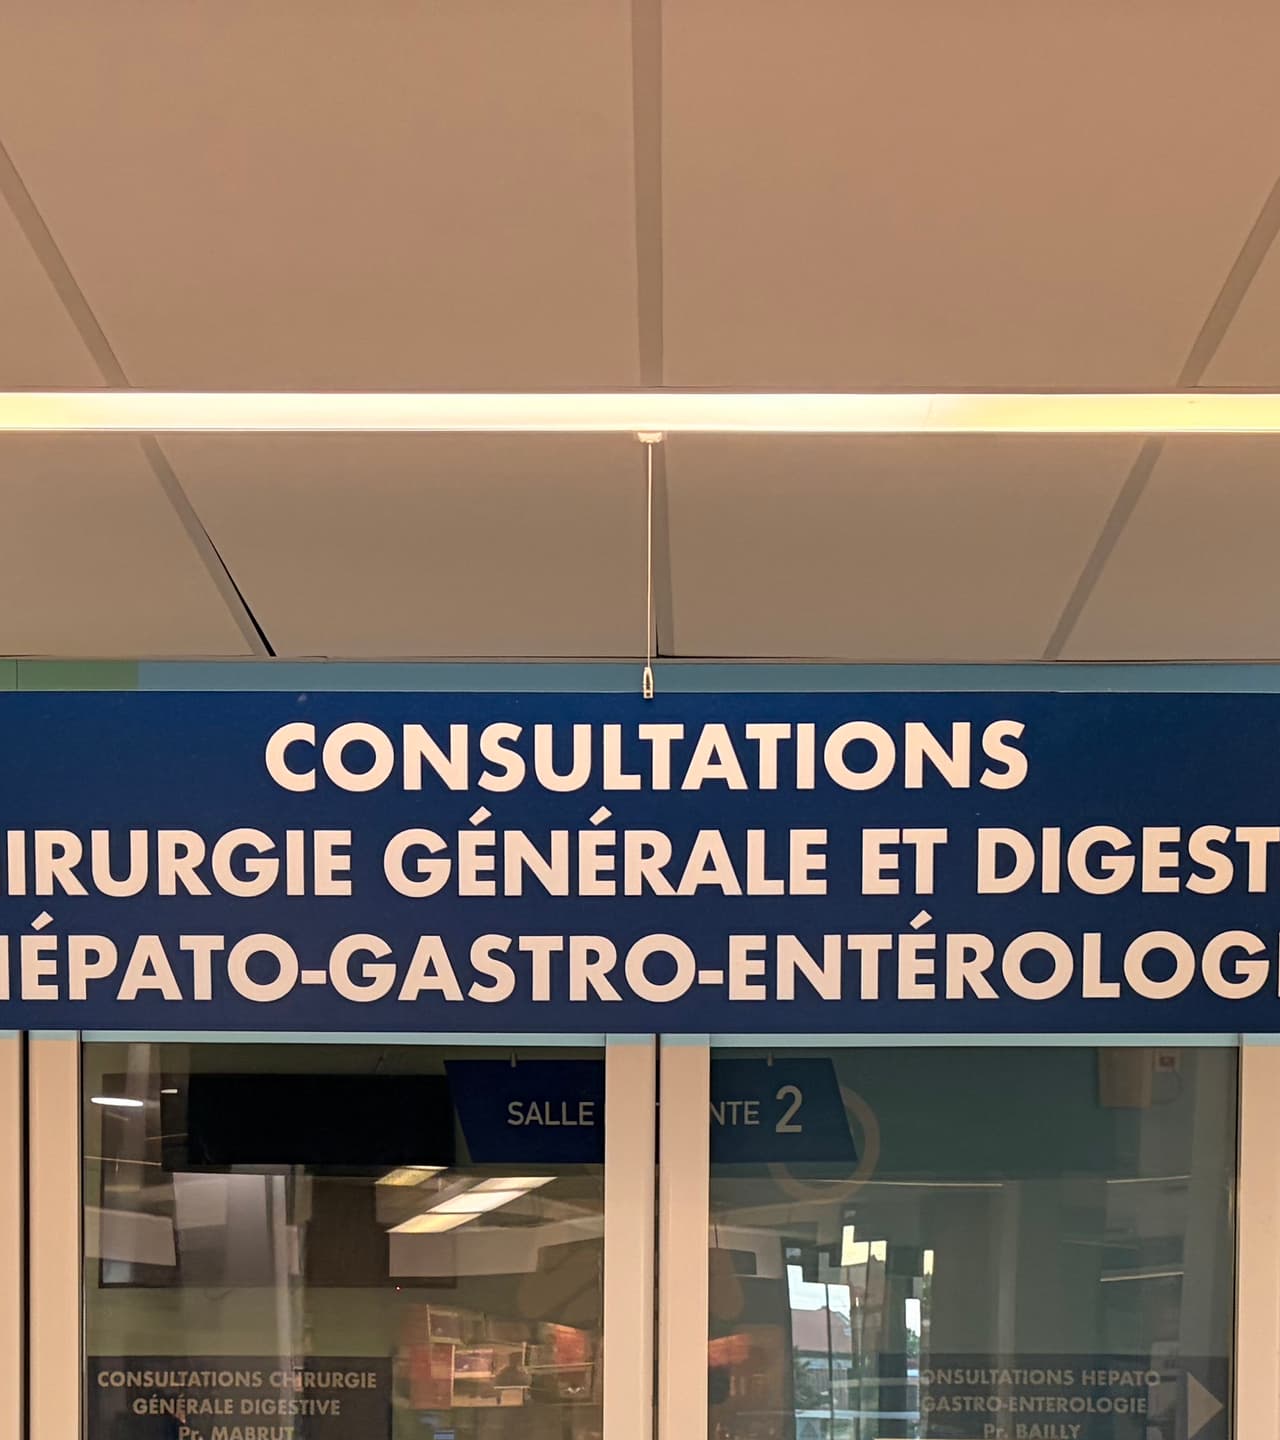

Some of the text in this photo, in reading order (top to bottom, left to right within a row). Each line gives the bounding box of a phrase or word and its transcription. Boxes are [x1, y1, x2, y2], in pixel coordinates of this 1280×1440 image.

[265, 719, 1028, 792] CONSULTATIONS
[383, 805, 828, 898] GÉNÉRALE
[861, 828, 948, 895] ET
[507, 1101, 595, 1126] SALLE
[775, 1085, 803, 1133] 2
[96, 1370, 377, 1389] CONSULTATIONS CHIRURGIE
[919, 1368, 1160, 1386] ONSULTATIONS HEPATO
[132, 1394, 341, 1416] GÉNÉRALE DIGESTIVE
[922, 1396, 1148, 1414] GASTRO-ENTEROLOGIE
[983, 1423, 1081, 1440] Pr. BAILLY
